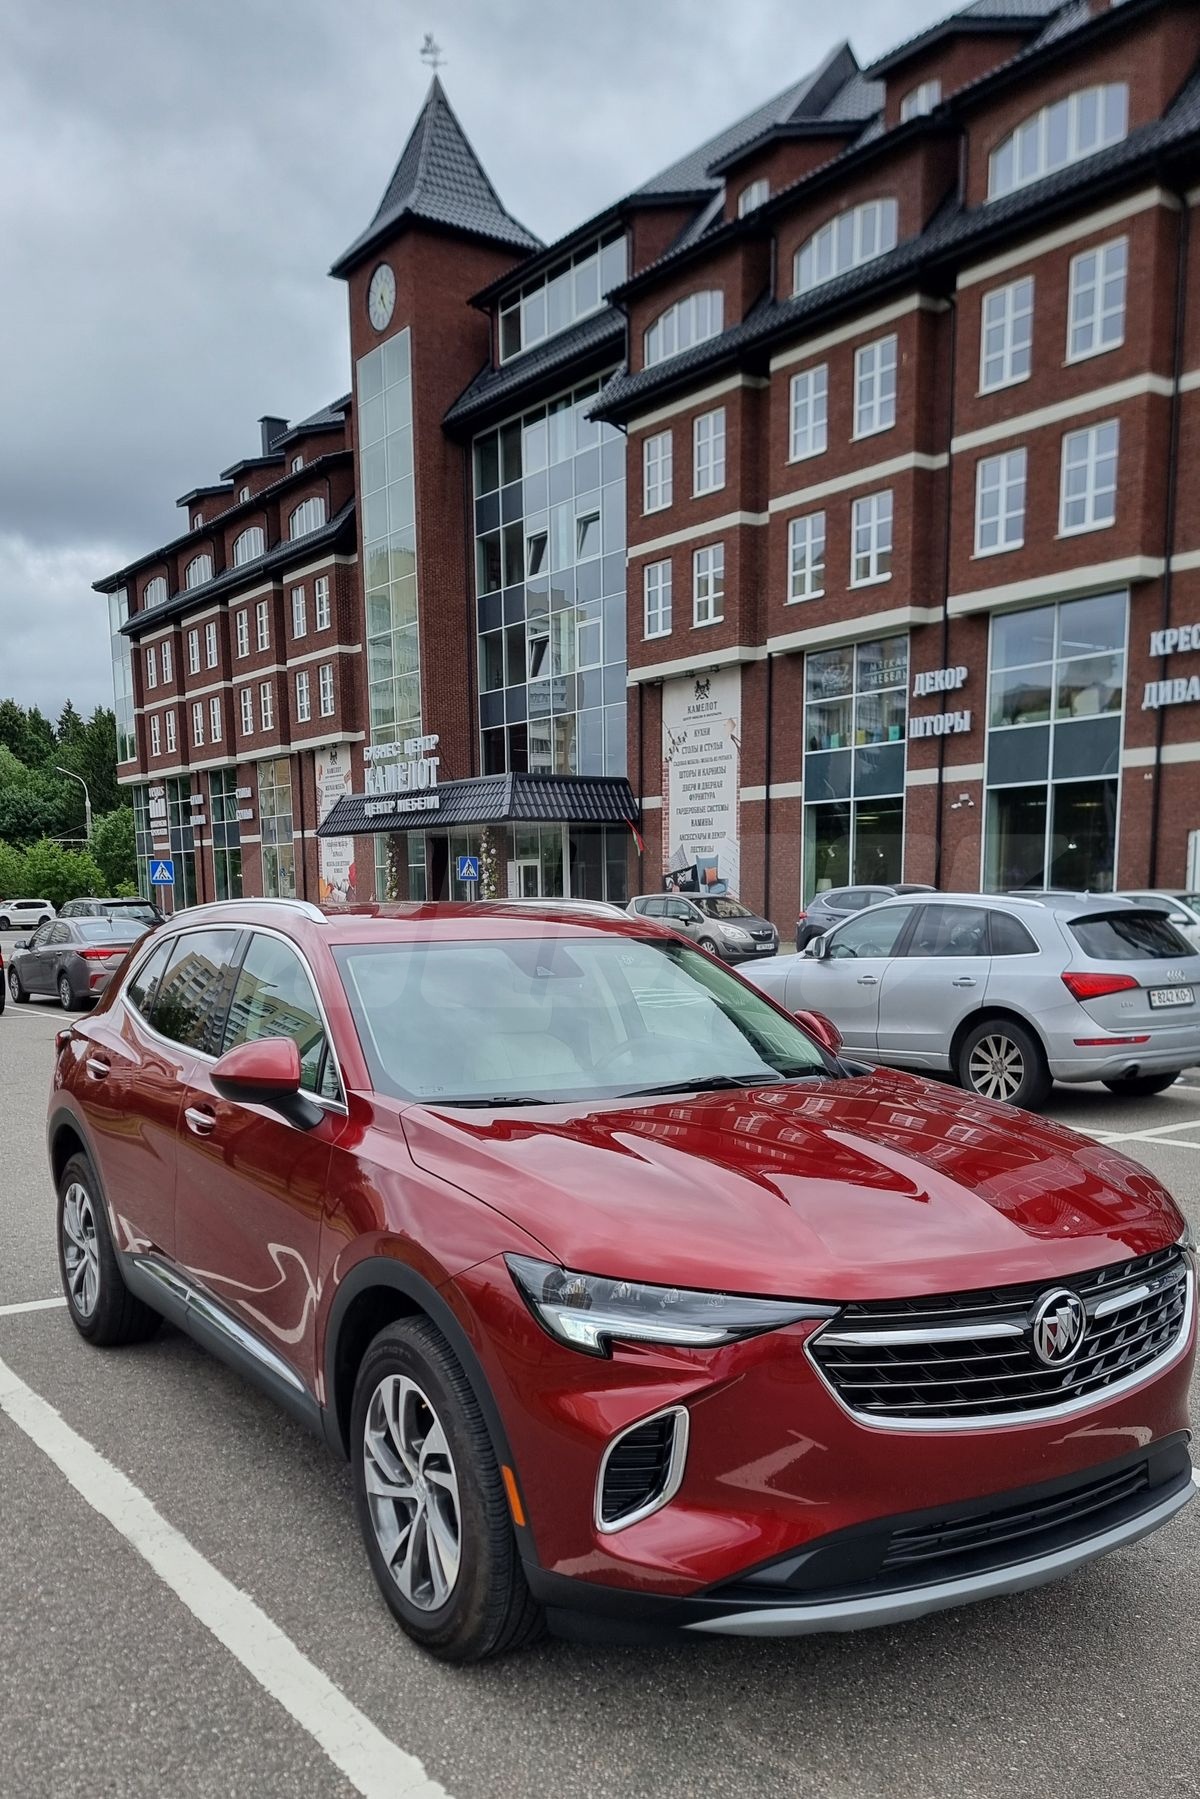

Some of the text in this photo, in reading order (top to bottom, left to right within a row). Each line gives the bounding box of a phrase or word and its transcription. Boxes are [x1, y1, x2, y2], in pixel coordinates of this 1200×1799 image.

[1149, 623, 1200, 657] КРЕС
[912, 666, 968, 697] ДЕКОР
[1141, 675, 1200, 711] ДИВА
[688, 701, 718, 714] КАМЕЛОТ
[909, 710, 971, 738] ШТОРЫ
[364, 734, 439, 761] БИЗНЕС ЦЕНТР
[364, 757, 440, 796] КАМЕЛОТ
[679, 770, 697, 779] ШТОРЫ
[365, 796, 440, 817] ЦЕНТР МЕБЕЛИ
[691, 818, 713, 827] КАМИНЫ
[1157, 990, 1174, 1003] 8242
